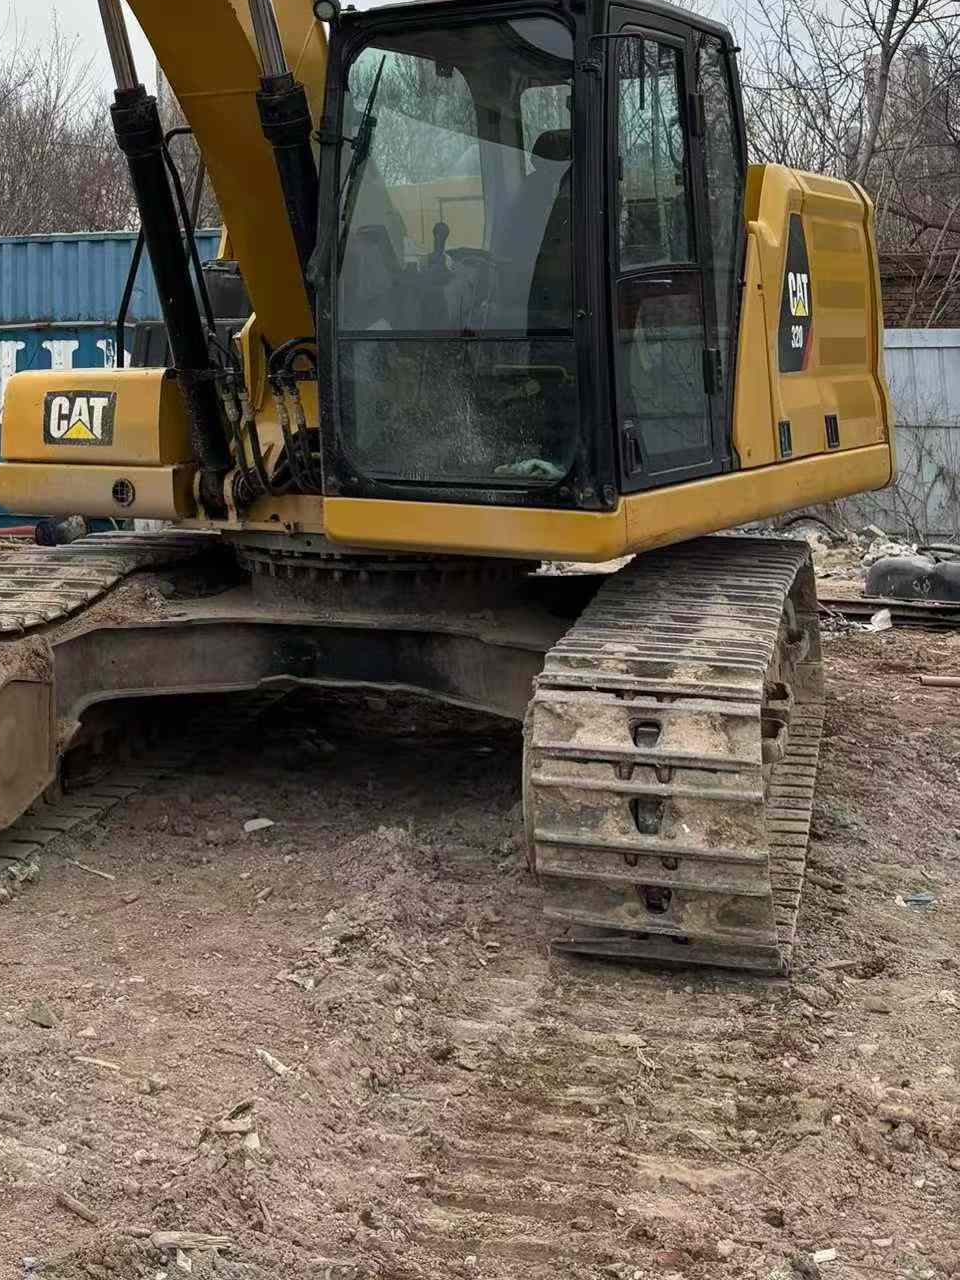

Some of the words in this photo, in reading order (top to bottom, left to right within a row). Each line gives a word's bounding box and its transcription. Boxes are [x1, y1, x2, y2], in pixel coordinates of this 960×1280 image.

[788, 272, 808, 316] CAT
[791, 324, 803, 348] 320
[50, 396, 109, 439] CAT
